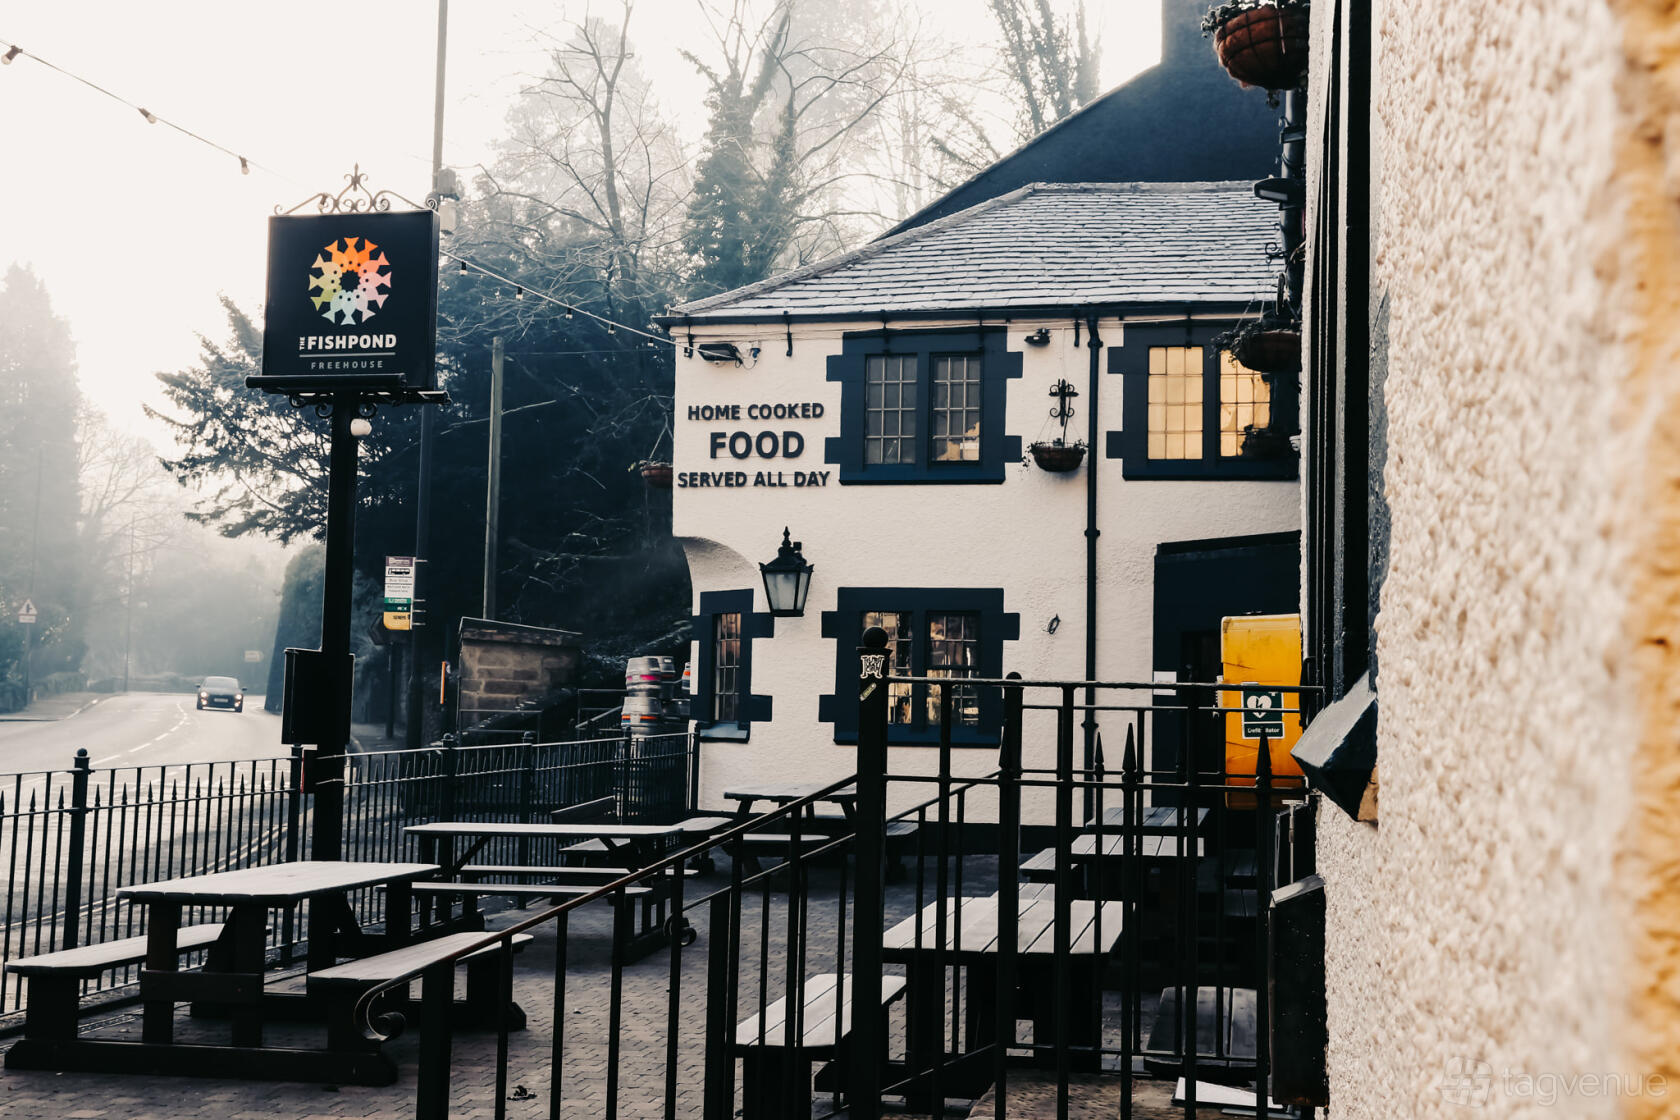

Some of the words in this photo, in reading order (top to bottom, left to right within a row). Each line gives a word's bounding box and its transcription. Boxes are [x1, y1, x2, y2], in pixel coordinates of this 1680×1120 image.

[307, 334, 397, 350] FISHPOND
[311, 360, 383, 369] FREEHOUSE
[688, 405, 741, 420] HOME
[747, 403, 824, 420] COOKED
[710, 431, 805, 459] FOOD
[677, 472, 747, 488] SERVED
[753, 472, 787, 487] ALL
[794, 471, 830, 487] DAY
